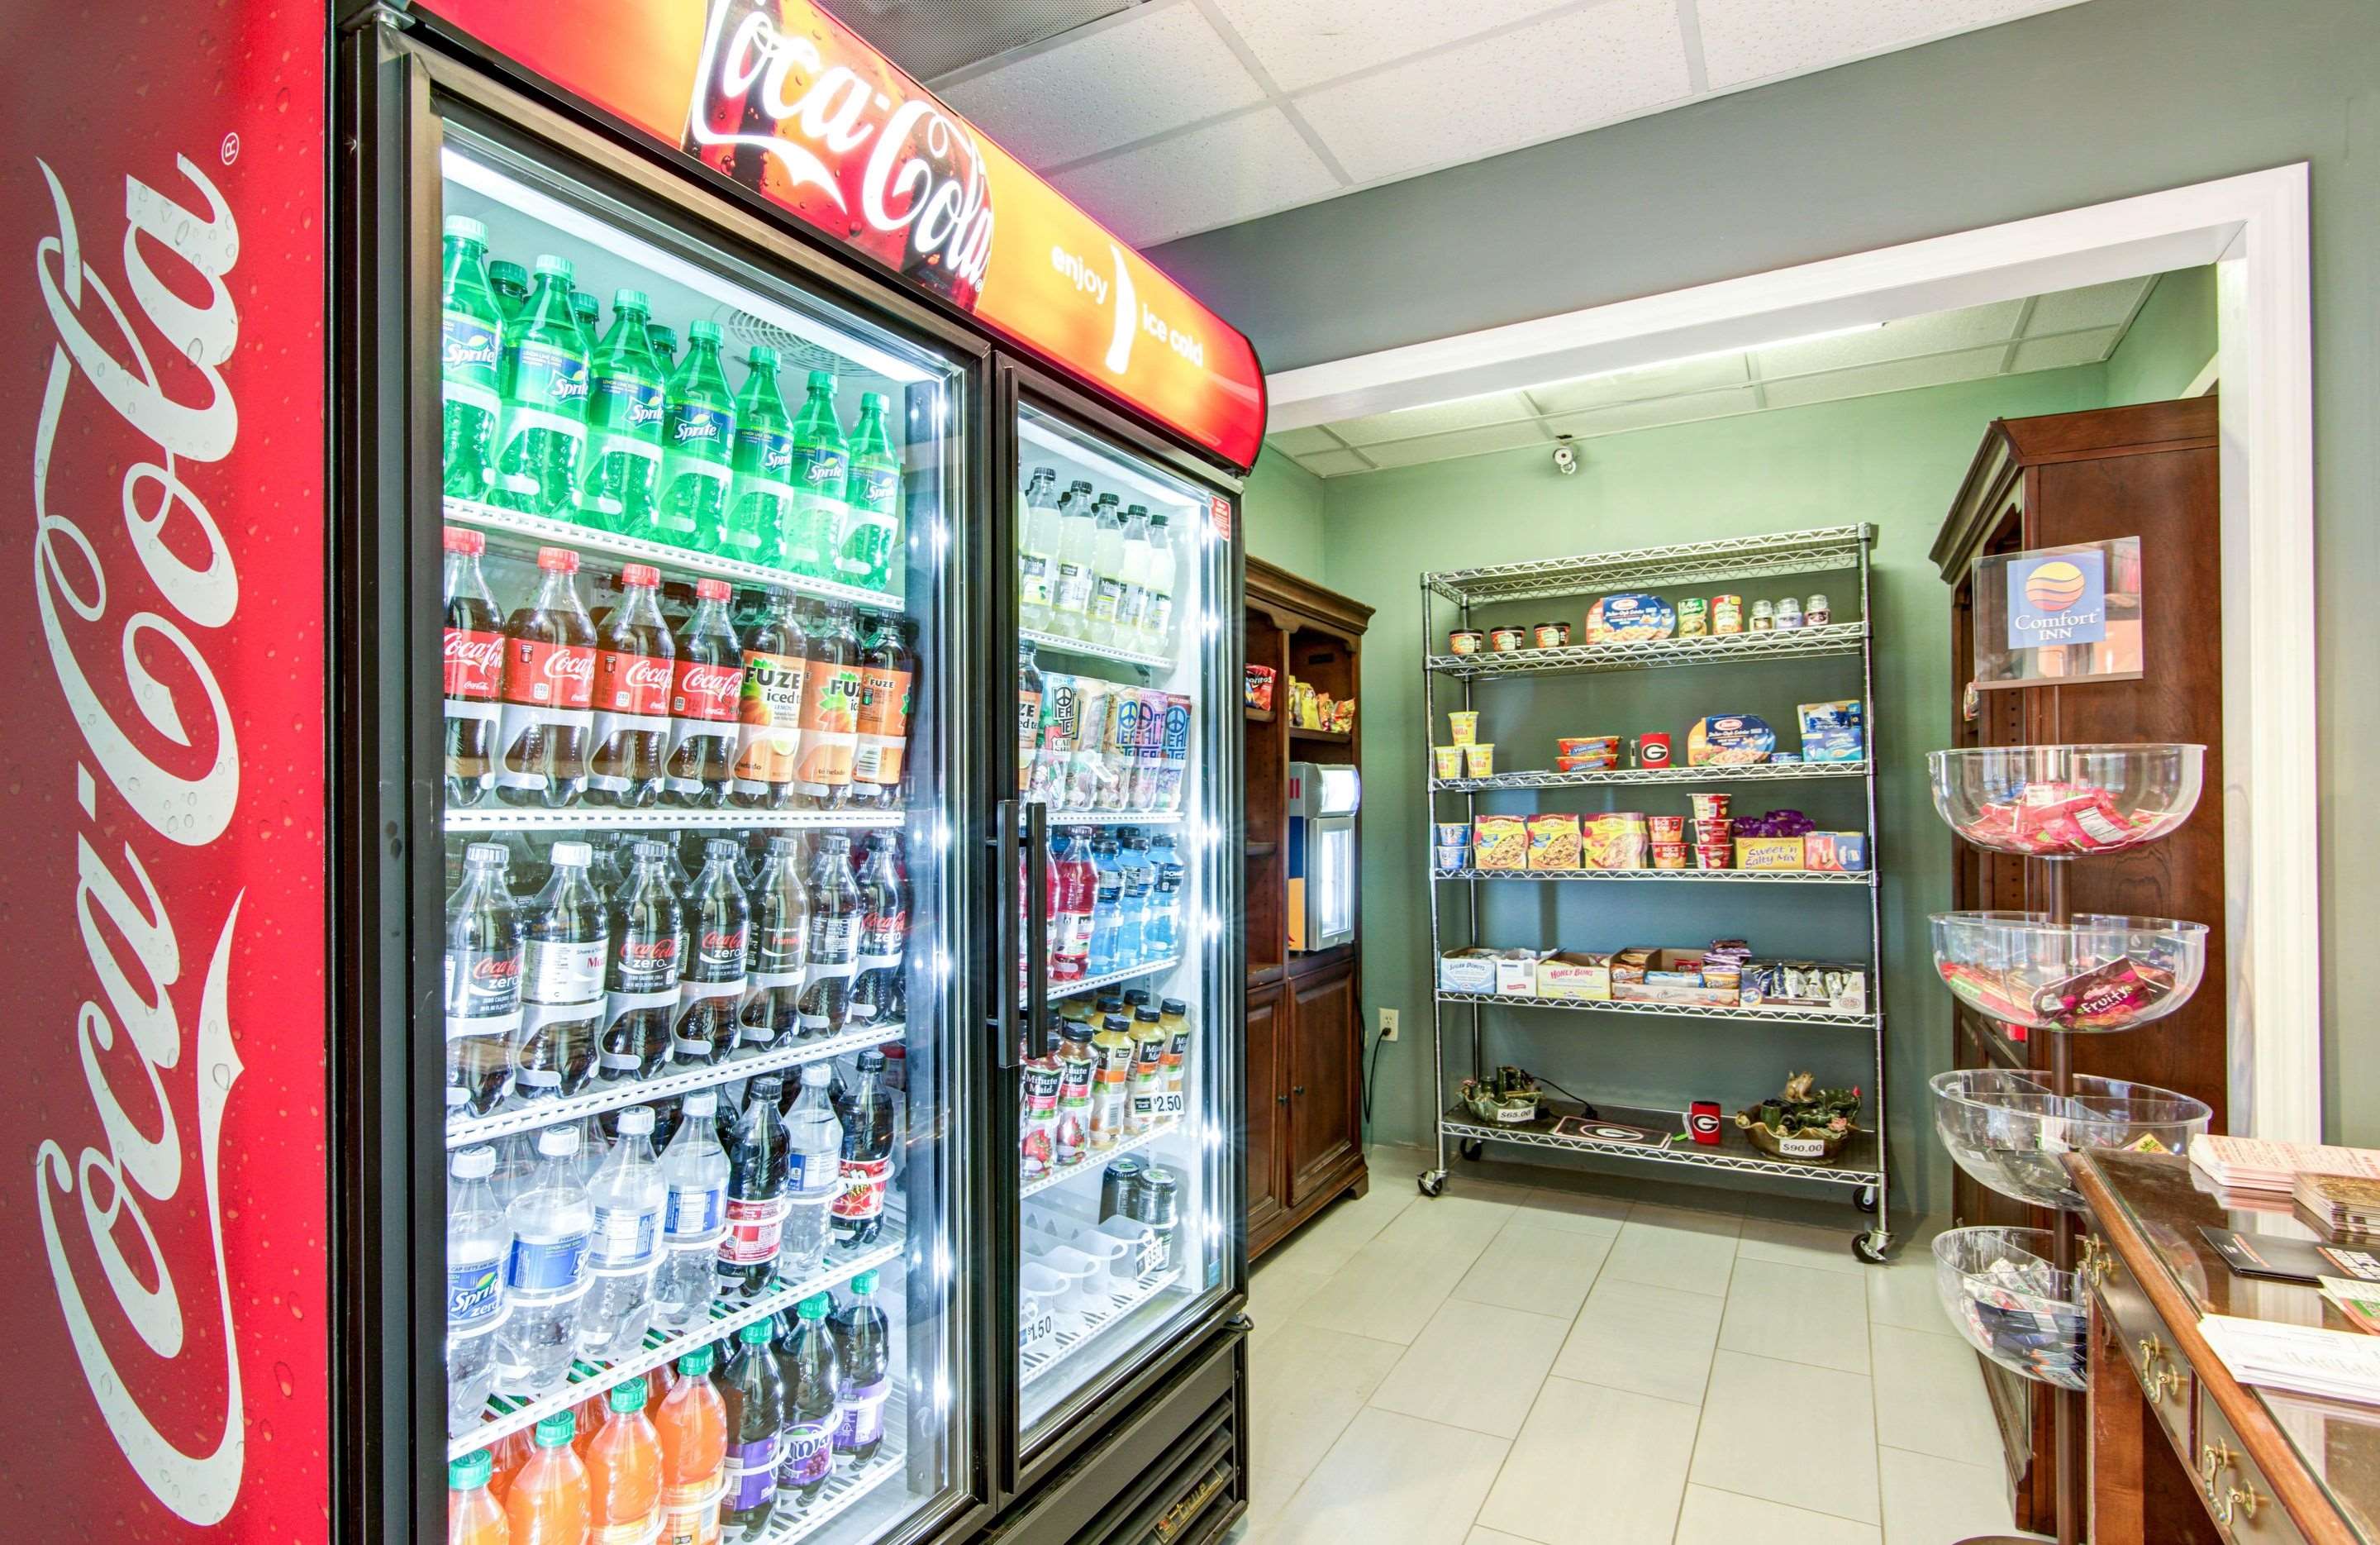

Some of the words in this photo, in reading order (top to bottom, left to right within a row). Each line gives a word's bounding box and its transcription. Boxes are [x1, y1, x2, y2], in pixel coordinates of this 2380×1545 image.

[691, 0, 992, 286] Coca-Cola
[1051, 246, 1108, 305] enjoy
[1142, 302, 1168, 343] ice
[1169, 329, 1204, 369] cold
[444, 342, 495, 366] Sprite
[674, 422, 716, 441] Sprite
[2015, 609, 2097, 631] Comfort
[2038, 627, 2073, 641] INN
[745, 666, 800, 689] FUZE
[870, 679, 894, 689] FUZE
[830, 680, 861, 696] FUZ
[767, 689, 795, 703] iced
[1469, 761, 1487, 769] Nilla
[34, 152, 245, 1527] Coca-Cola
[1748, 846, 1785, 858] Sweet
[1745, 856, 1774, 869] Salty
[713, 948, 740, 958] zero
[488, 975, 519, 989] zero
[1026, 1074, 1058, 1085] Minute
[1029, 1082, 1052, 1094] Maid
[1154, 1094, 1181, 1112] $2.50
[1782, 1142, 1822, 1153] $90.00
